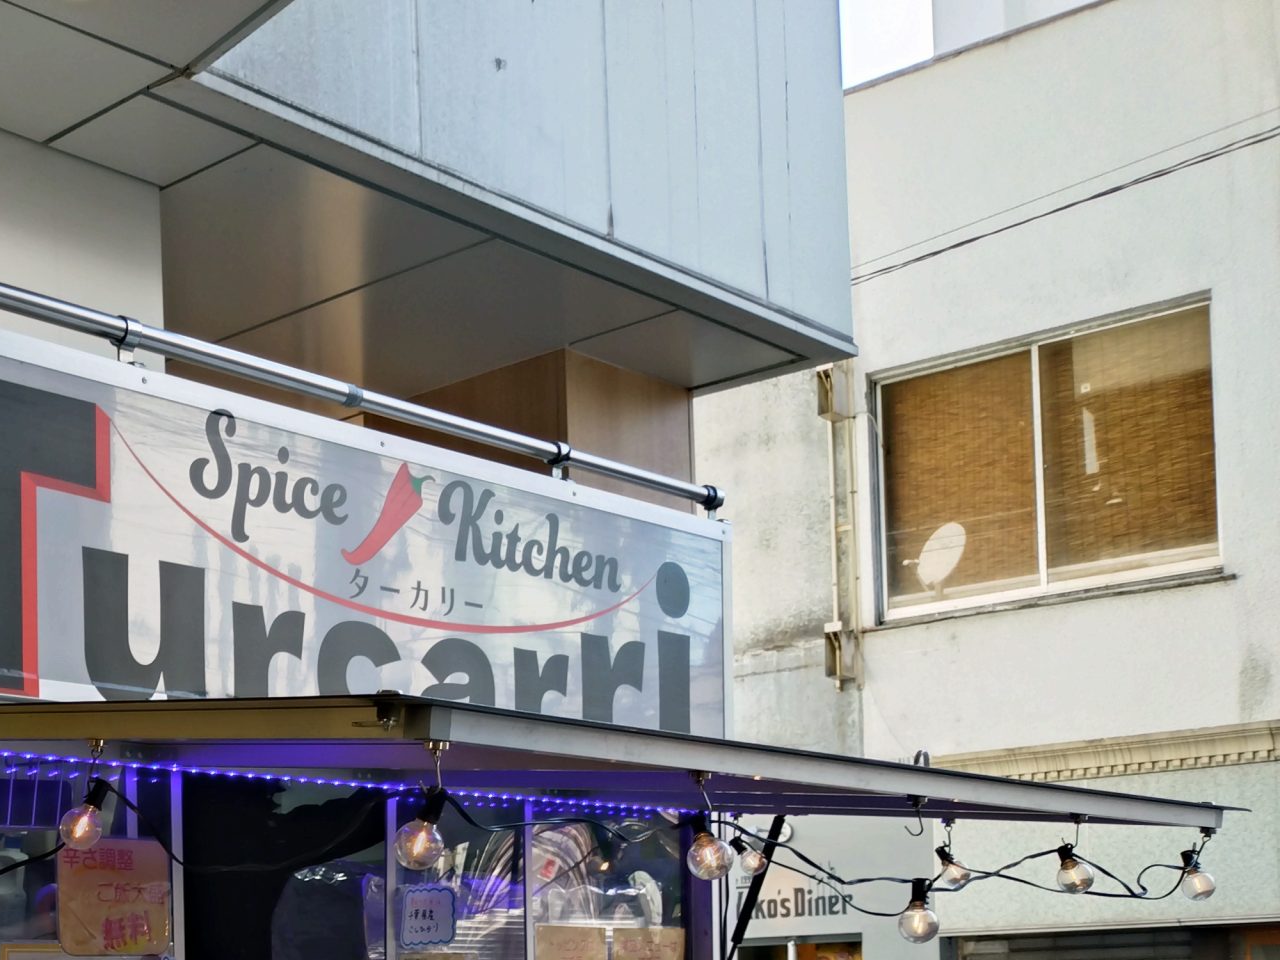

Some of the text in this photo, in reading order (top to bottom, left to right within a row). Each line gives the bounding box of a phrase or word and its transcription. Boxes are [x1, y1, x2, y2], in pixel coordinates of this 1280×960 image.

[189, 409, 622, 594] Spice Kitchen
[349, 566, 486, 616] ターカリー
[793, 887, 854, 918] Diner
[103, 910, 152, 950] 無料
